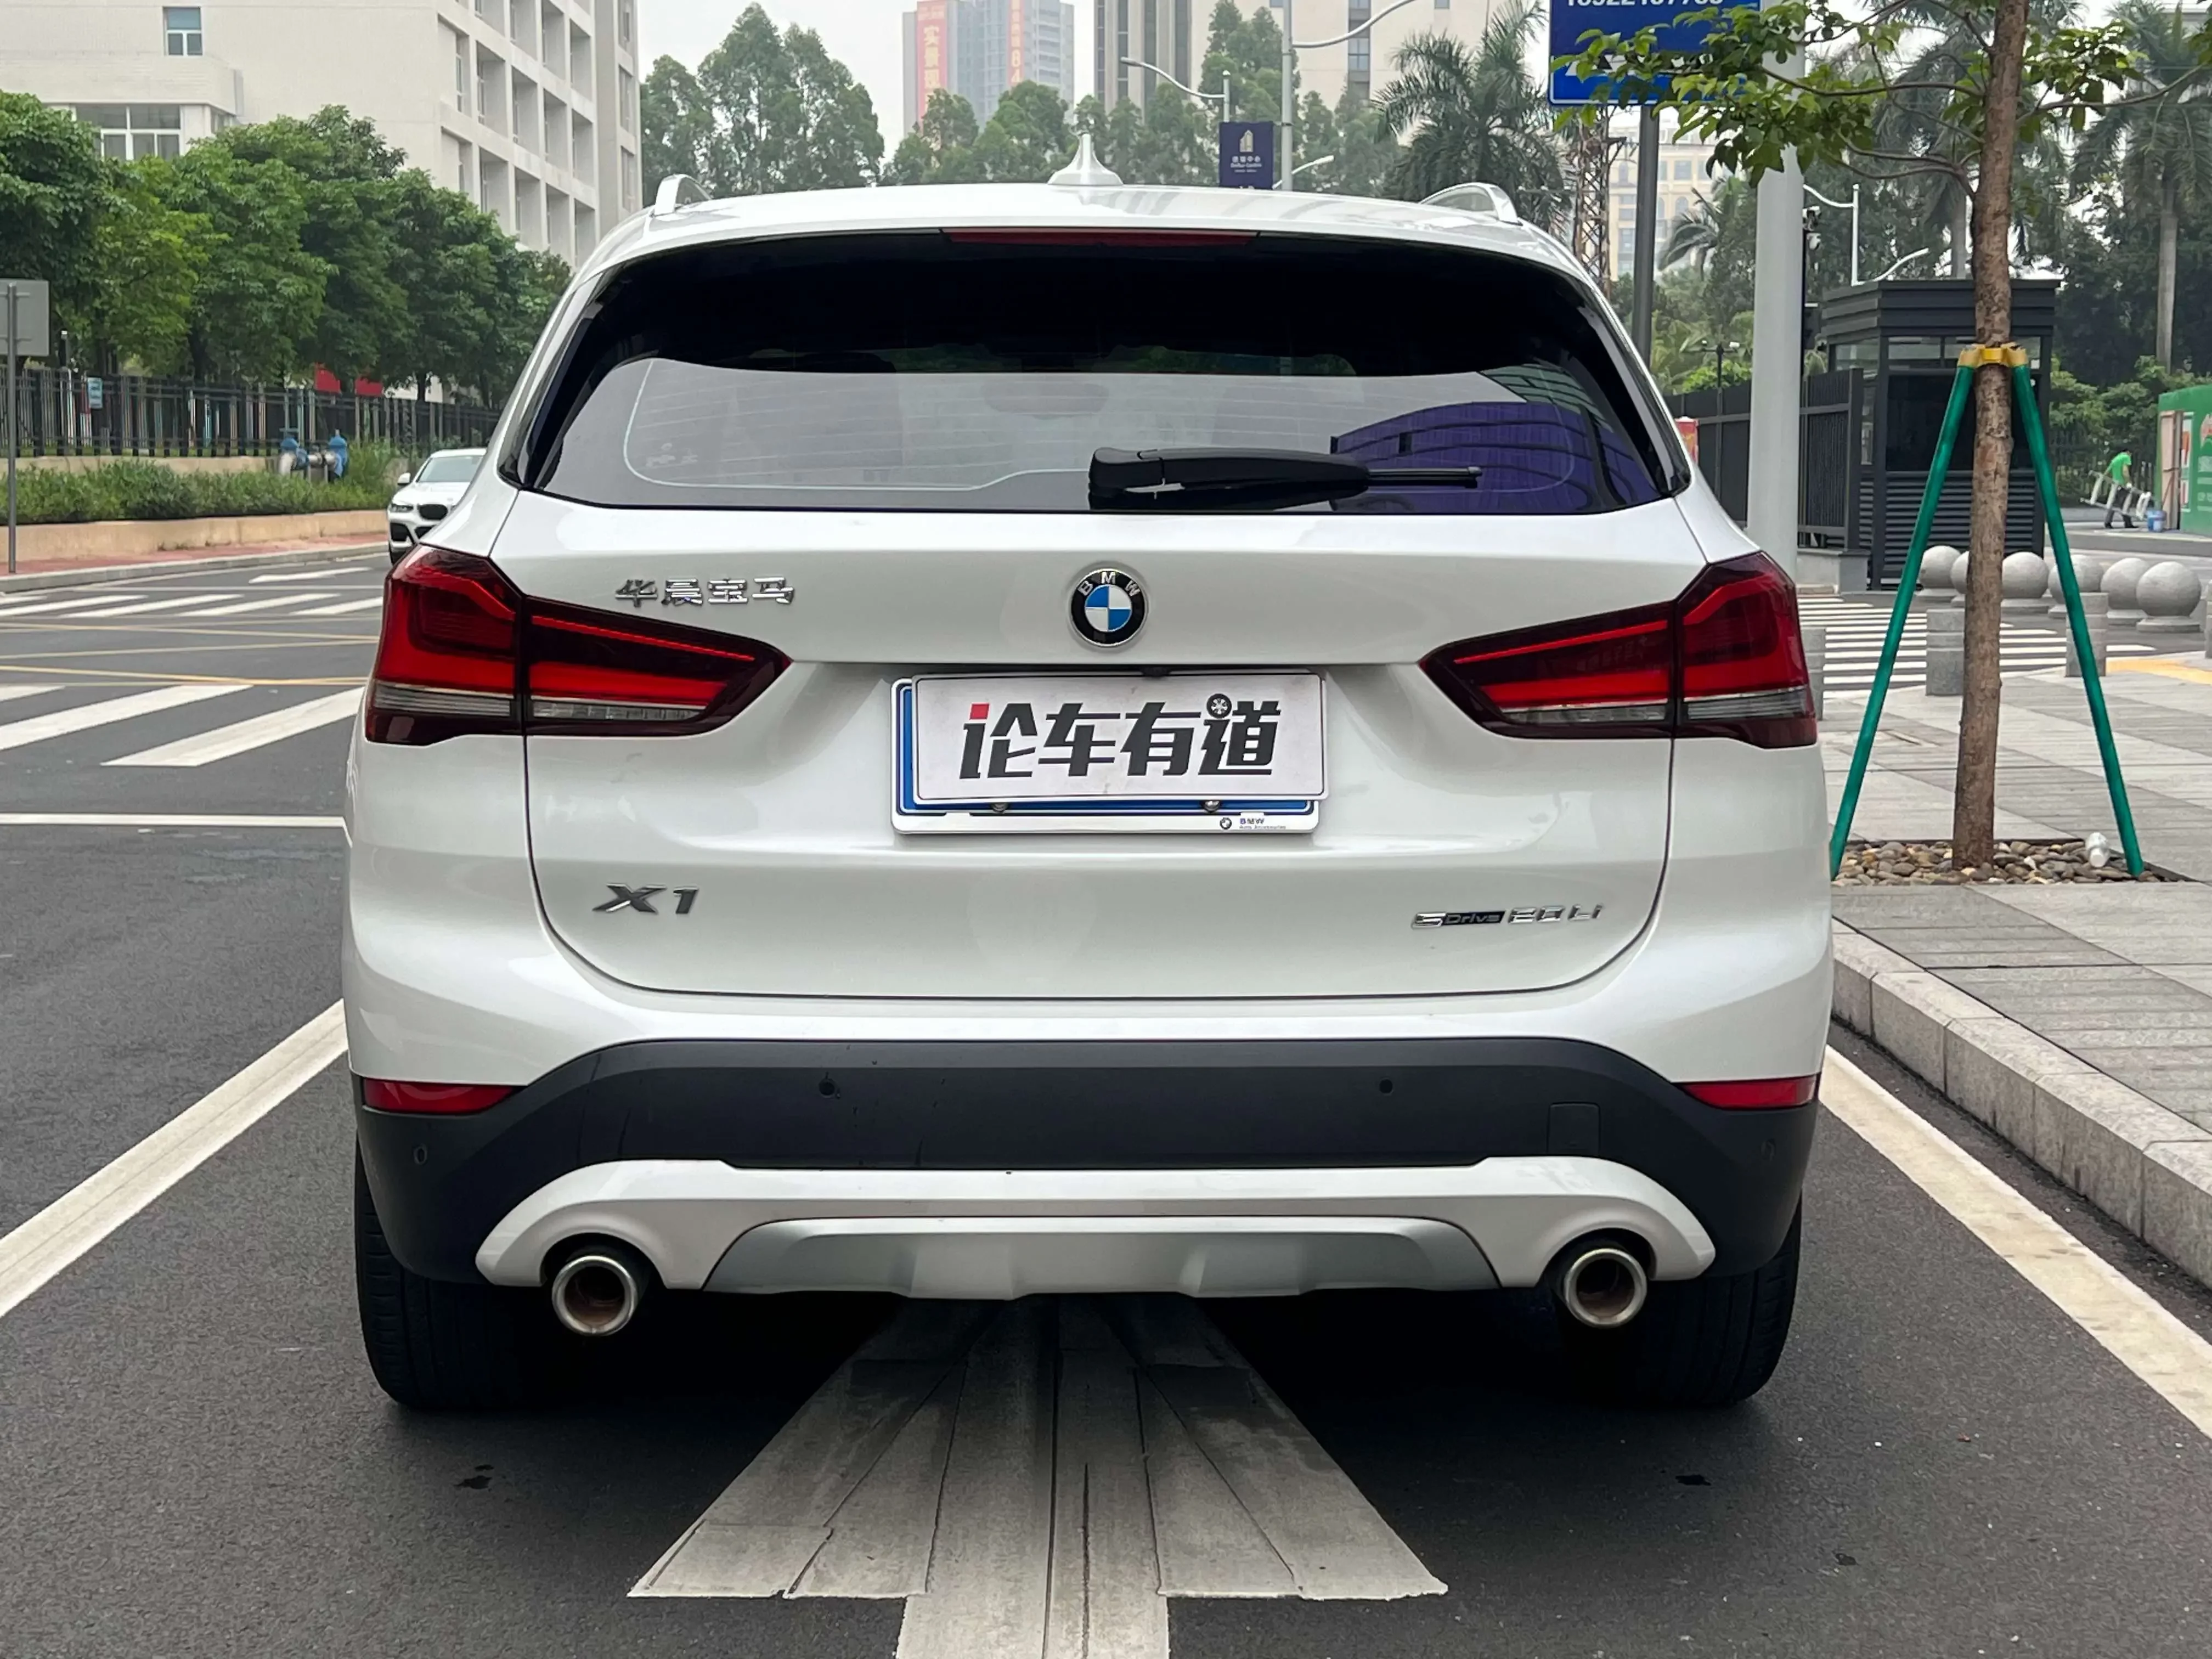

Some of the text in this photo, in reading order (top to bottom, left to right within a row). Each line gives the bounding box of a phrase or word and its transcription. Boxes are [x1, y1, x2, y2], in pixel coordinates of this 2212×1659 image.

[615, 577, 795, 607] 华晨宝马
[1077, 572, 1141, 596] BMW
[959, 693, 1281, 779] 论车有道
[592, 883, 699, 915] X1
